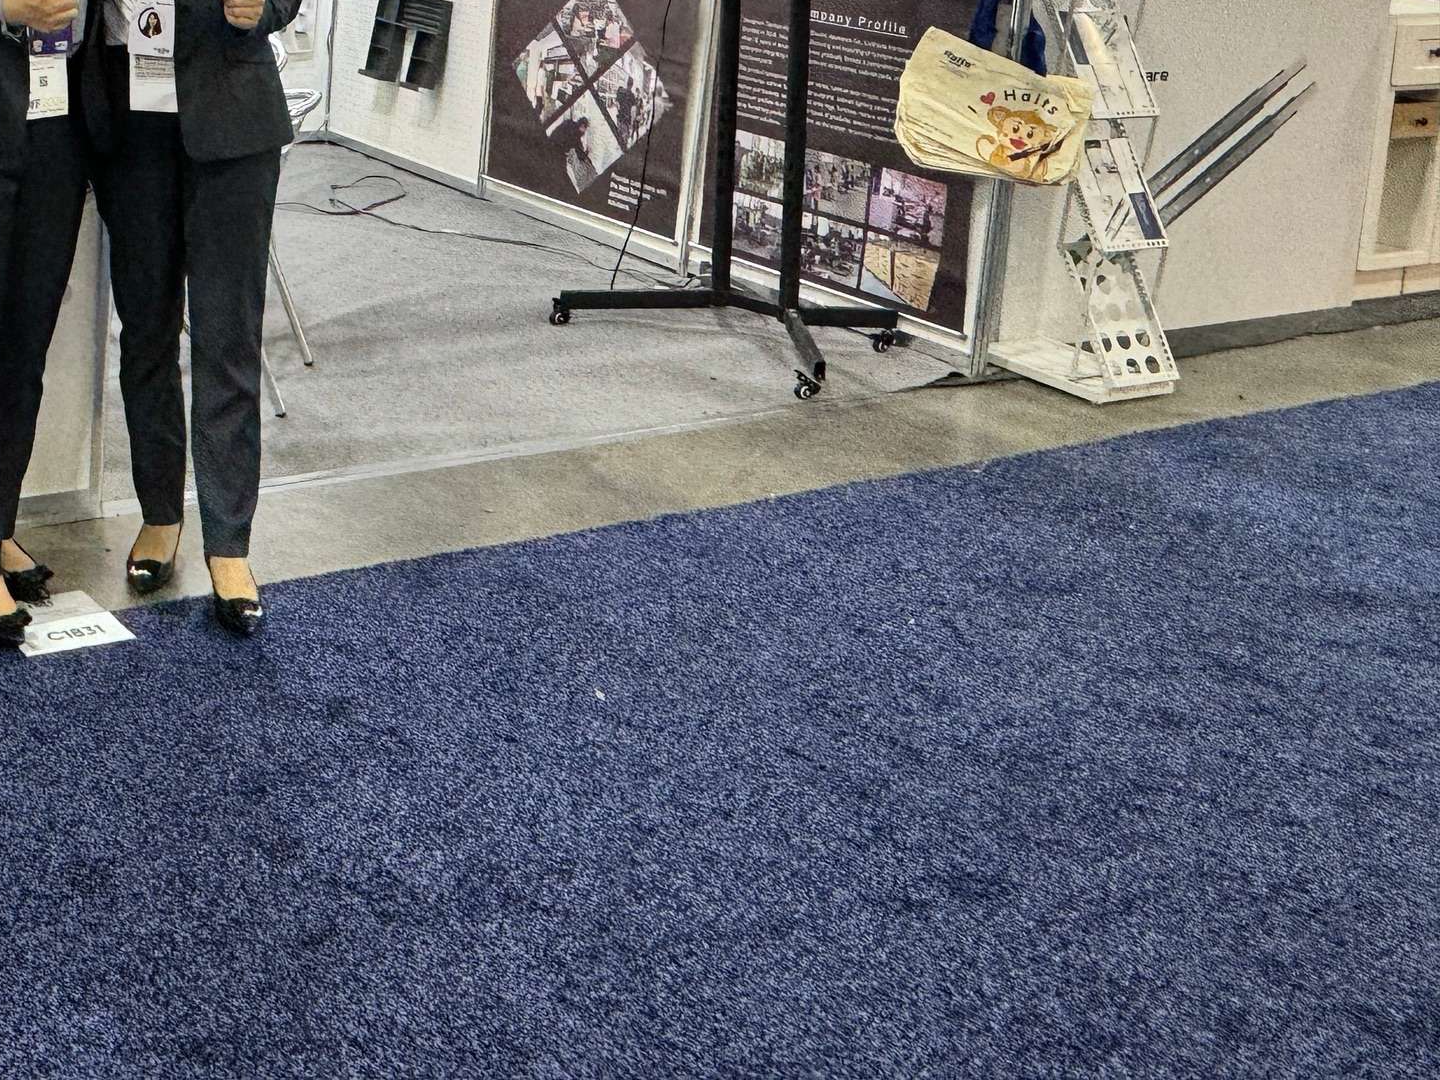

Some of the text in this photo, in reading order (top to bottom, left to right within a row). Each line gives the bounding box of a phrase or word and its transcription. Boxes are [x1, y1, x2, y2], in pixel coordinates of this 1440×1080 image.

[810, 9, 907, 35] mpany Profile
[1003, 88, 1059, 117] Haits
[47, 624, 106, 641] C1831
